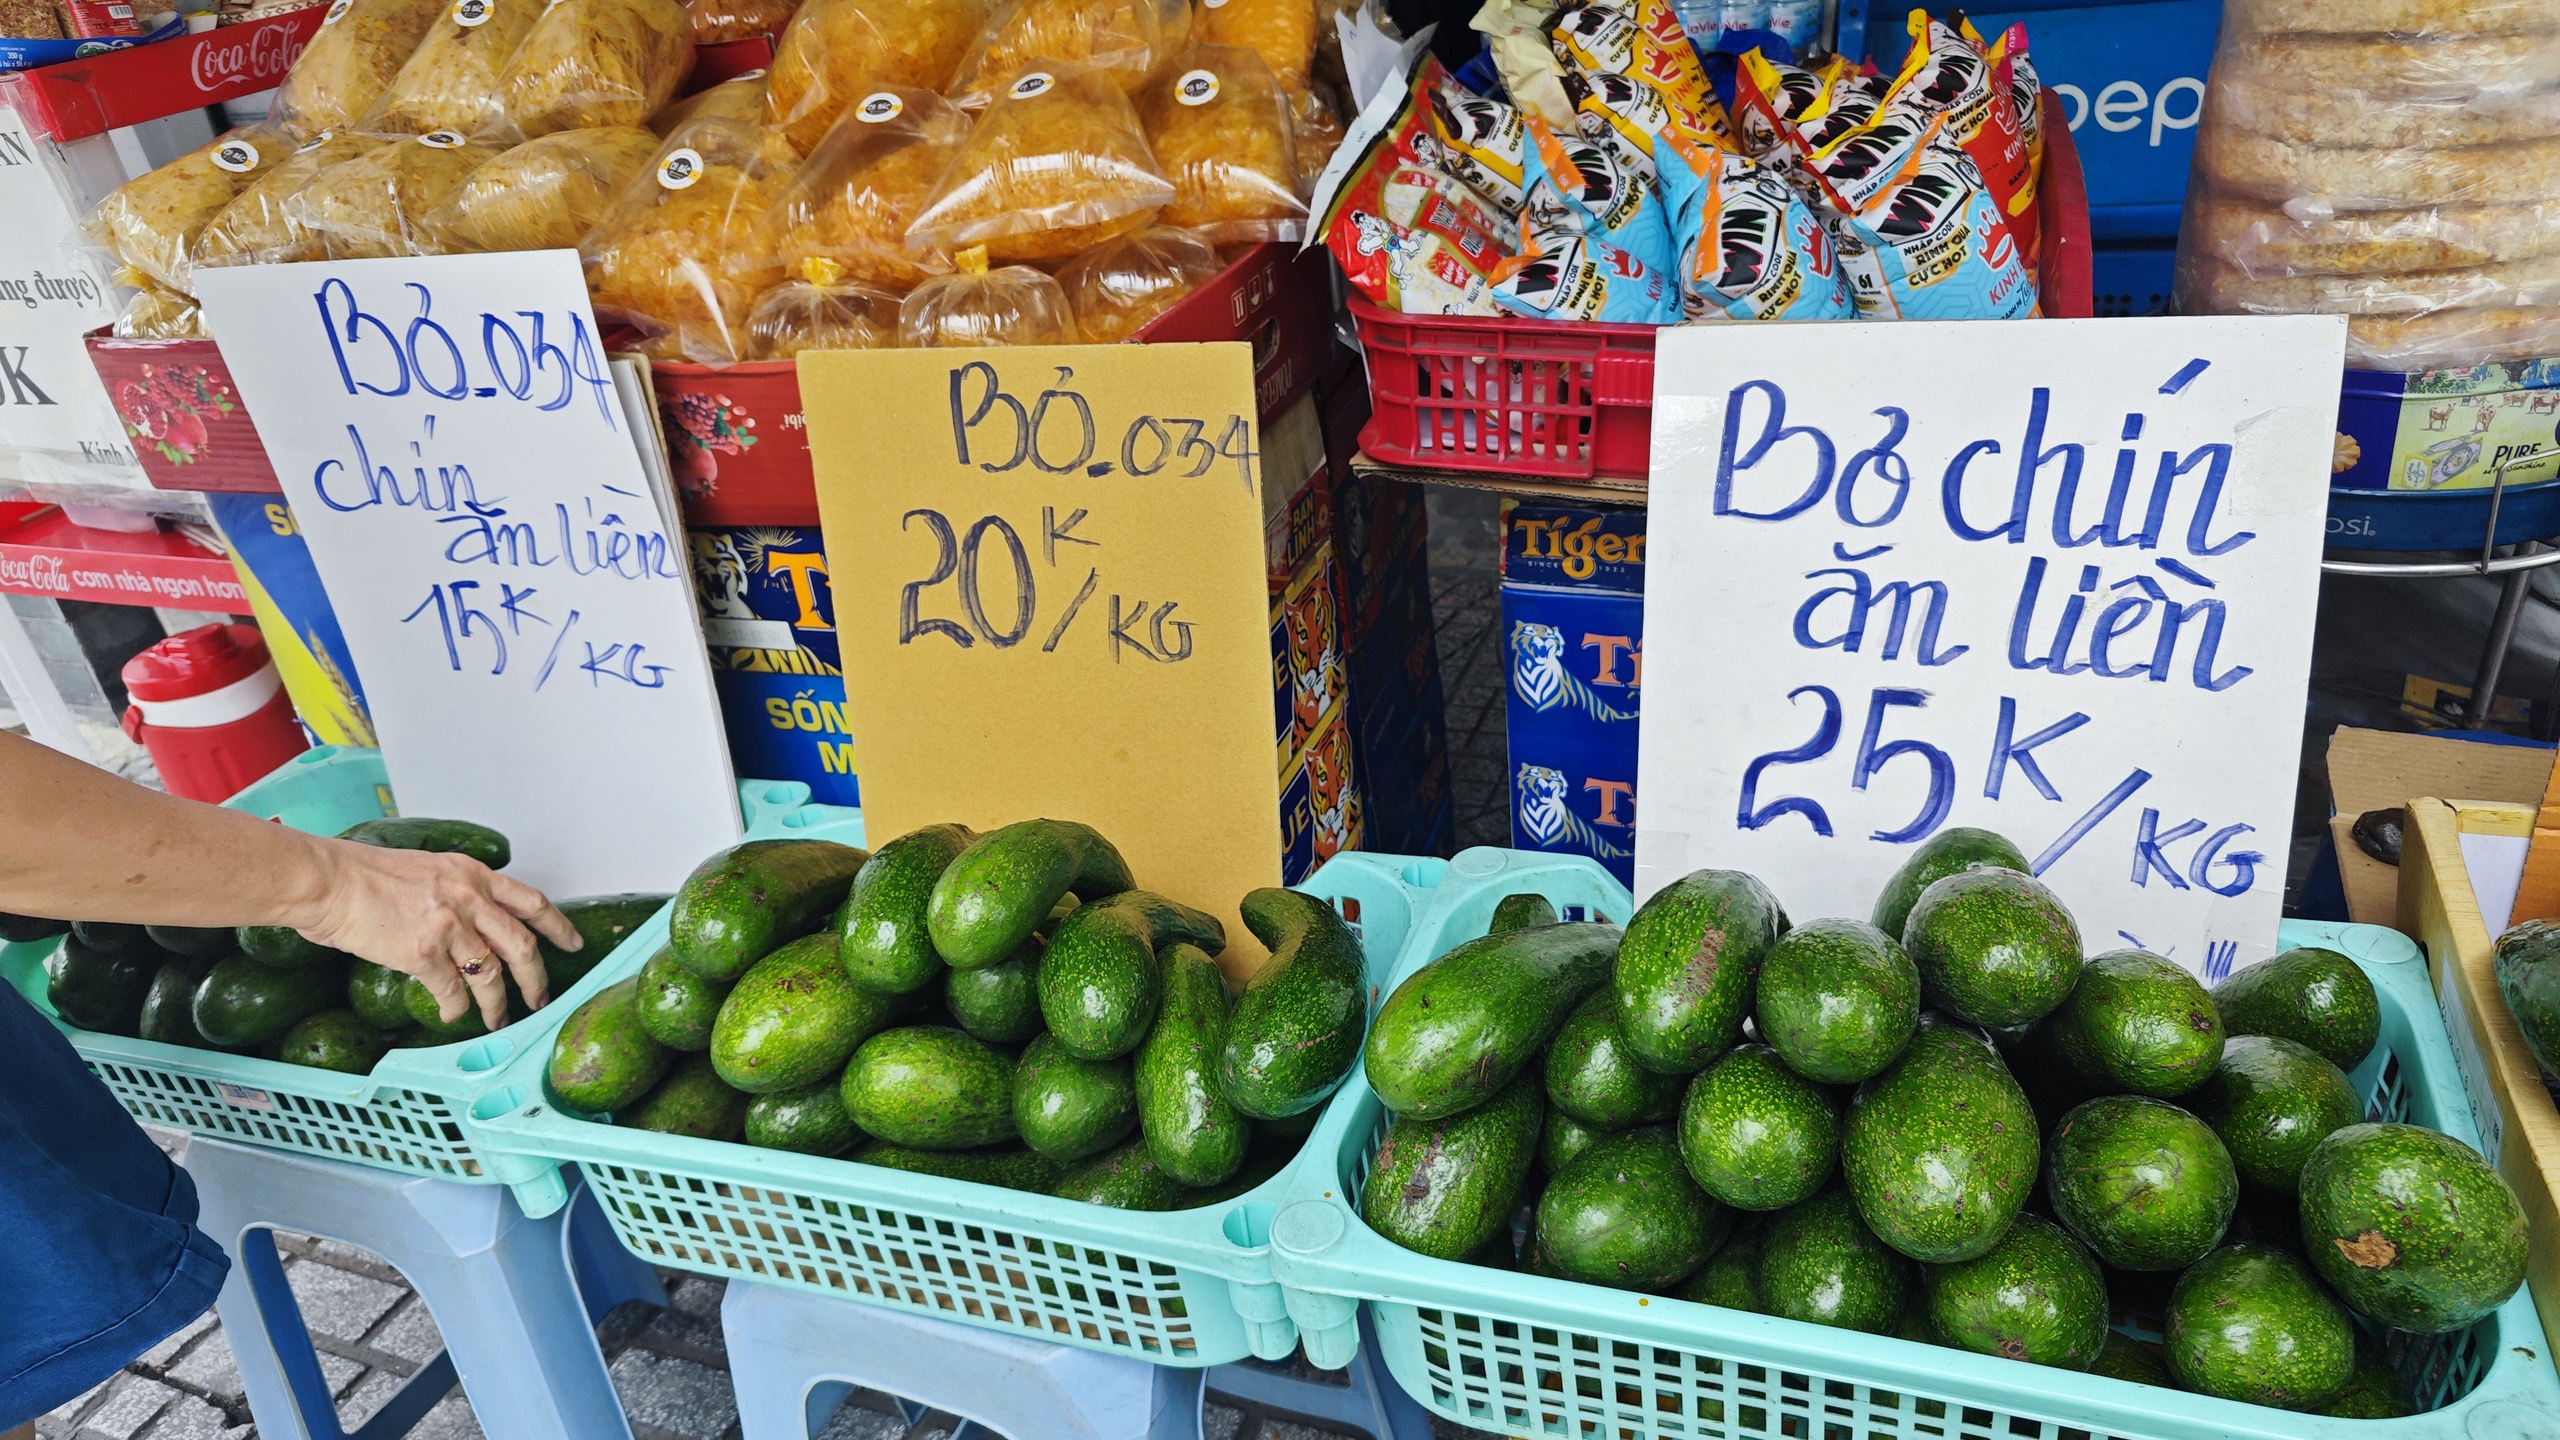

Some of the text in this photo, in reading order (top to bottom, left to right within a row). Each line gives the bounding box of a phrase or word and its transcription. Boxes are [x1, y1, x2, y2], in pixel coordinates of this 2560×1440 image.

[1969, 107, 1991, 128] HOT
[1876, 174, 1958, 237] WIN
[1716, 208, 1769, 288] WIN
[1903, 220, 1955, 257] NHẬP CODE
[1914, 223, 1972, 267] RINH QUÀ
[1568, 264, 1580, 284] CODE
[1782, 268, 1804, 301] HOT
[1783, 250, 1799, 277] QUÀ
[1857, 272, 1874, 290] 61
[1907, 244, 1968, 287] CỰC HOT
[1988, 263, 2020, 306] KINH
[1589, 273, 1607, 301] HOT
[0, 346, 59, 407] K
[314, 414, 509, 512] chín
[1941, 357, 2257, 557] chín
[1513, 514, 1648, 582] Tiger
[1527, 560, 1559, 569] SINCE
[152, 575, 202, 600] ngon
[2007, 555, 2256, 692] liền
